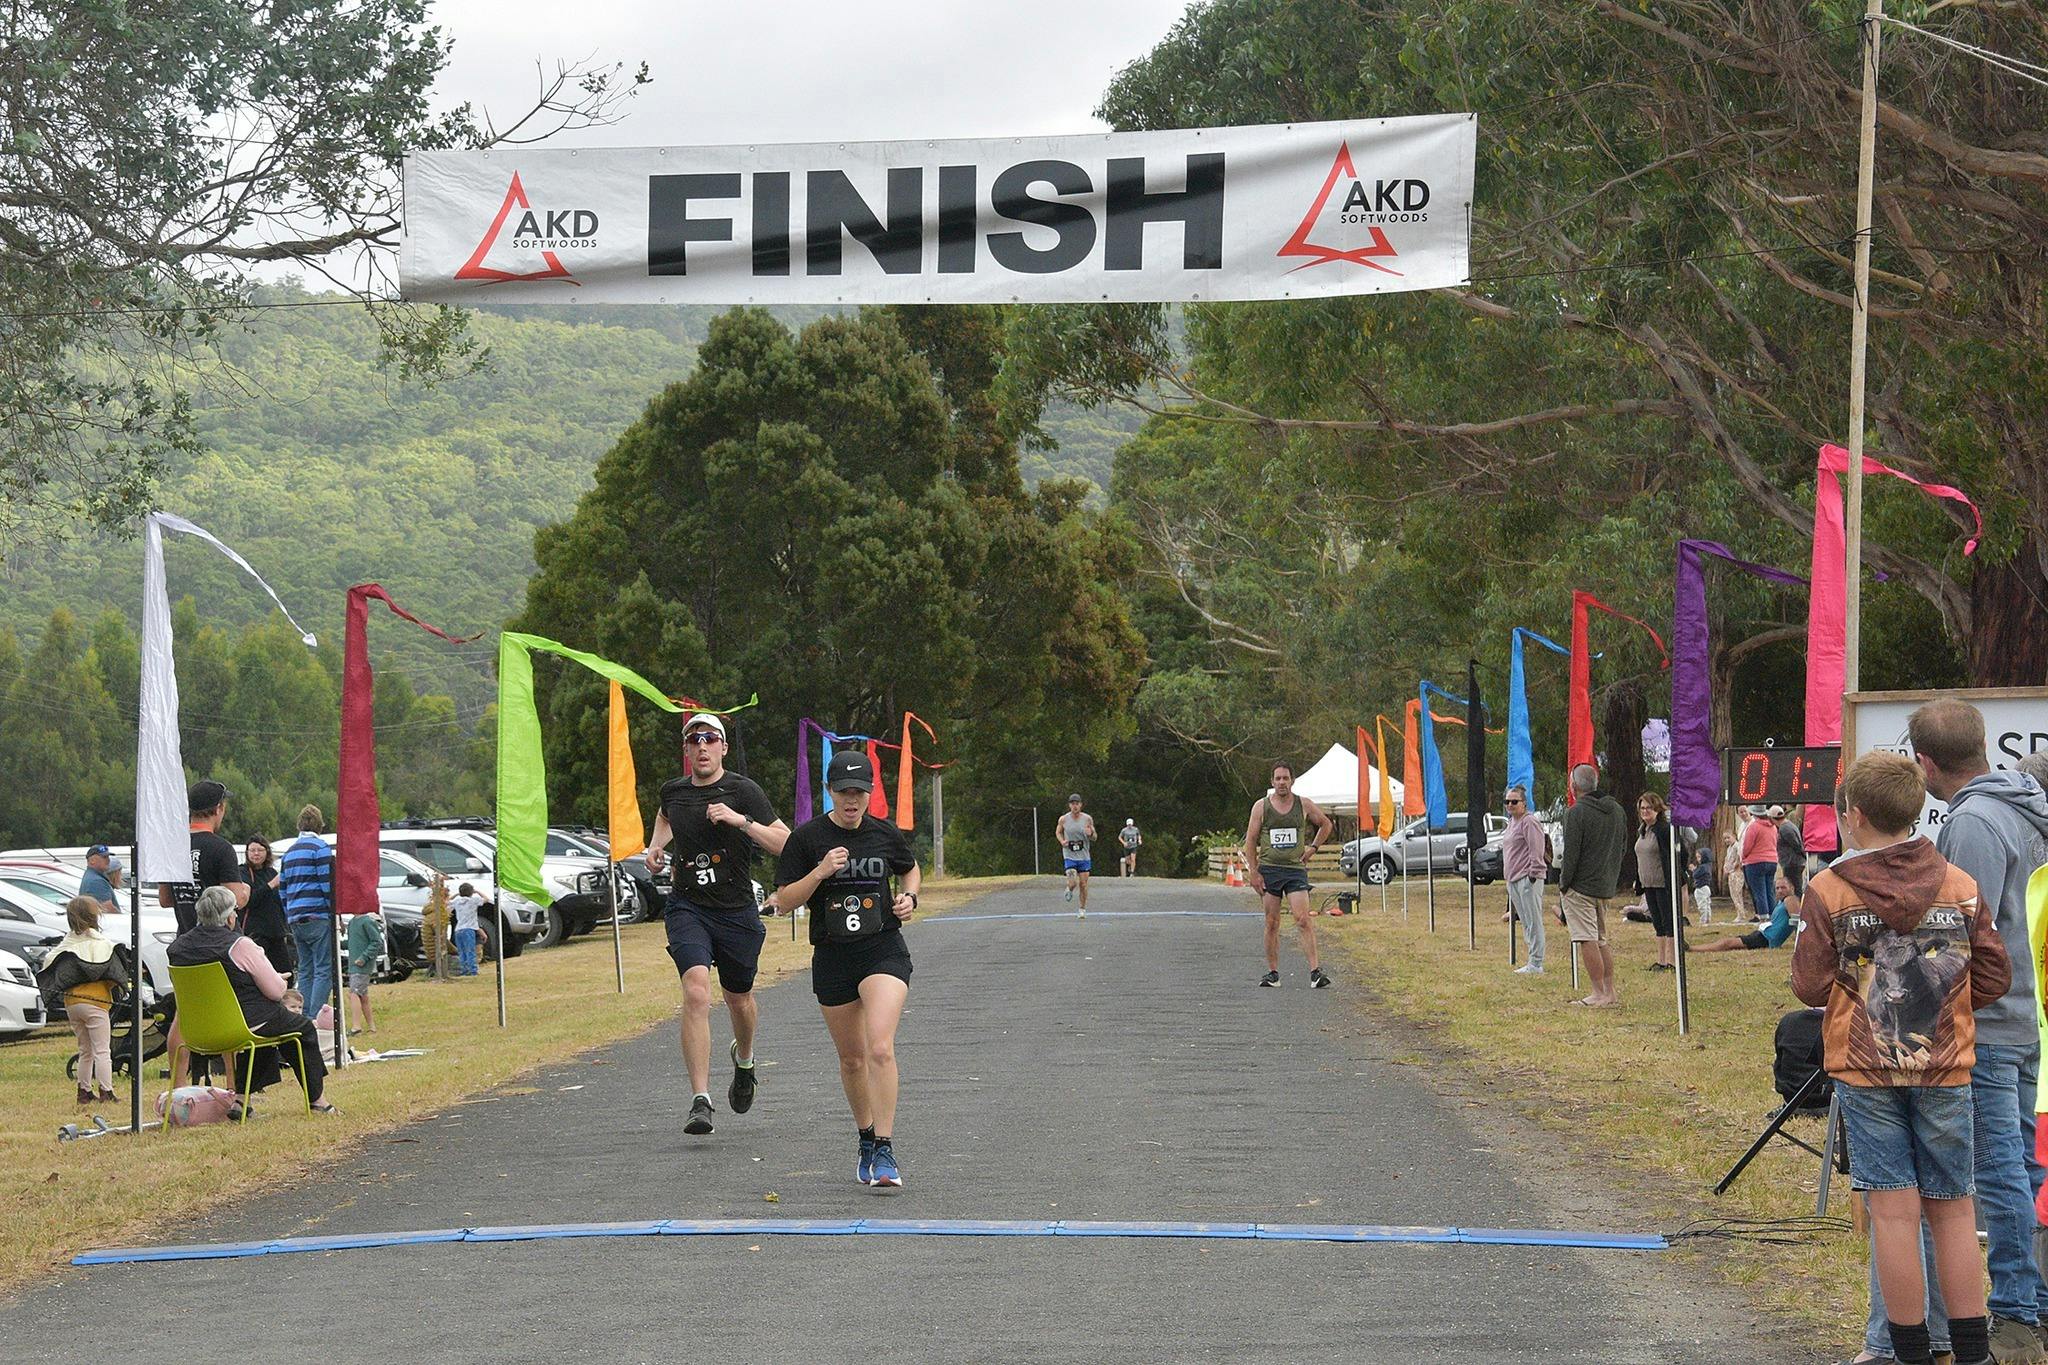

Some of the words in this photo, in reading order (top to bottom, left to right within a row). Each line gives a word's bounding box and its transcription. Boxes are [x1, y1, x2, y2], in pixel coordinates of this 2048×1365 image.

[1342, 180, 1430, 212] AKD
[649, 153, 1225, 276] FINISH
[1341, 213, 1428, 223] SOFTWOODS
[514, 210, 599, 238] AKD
[513, 240, 597, 248] SOFTWOODS
[1274, 833, 1292, 843] 571
[696, 868, 716, 885] 31
[846, 914, 861, 931] 6
